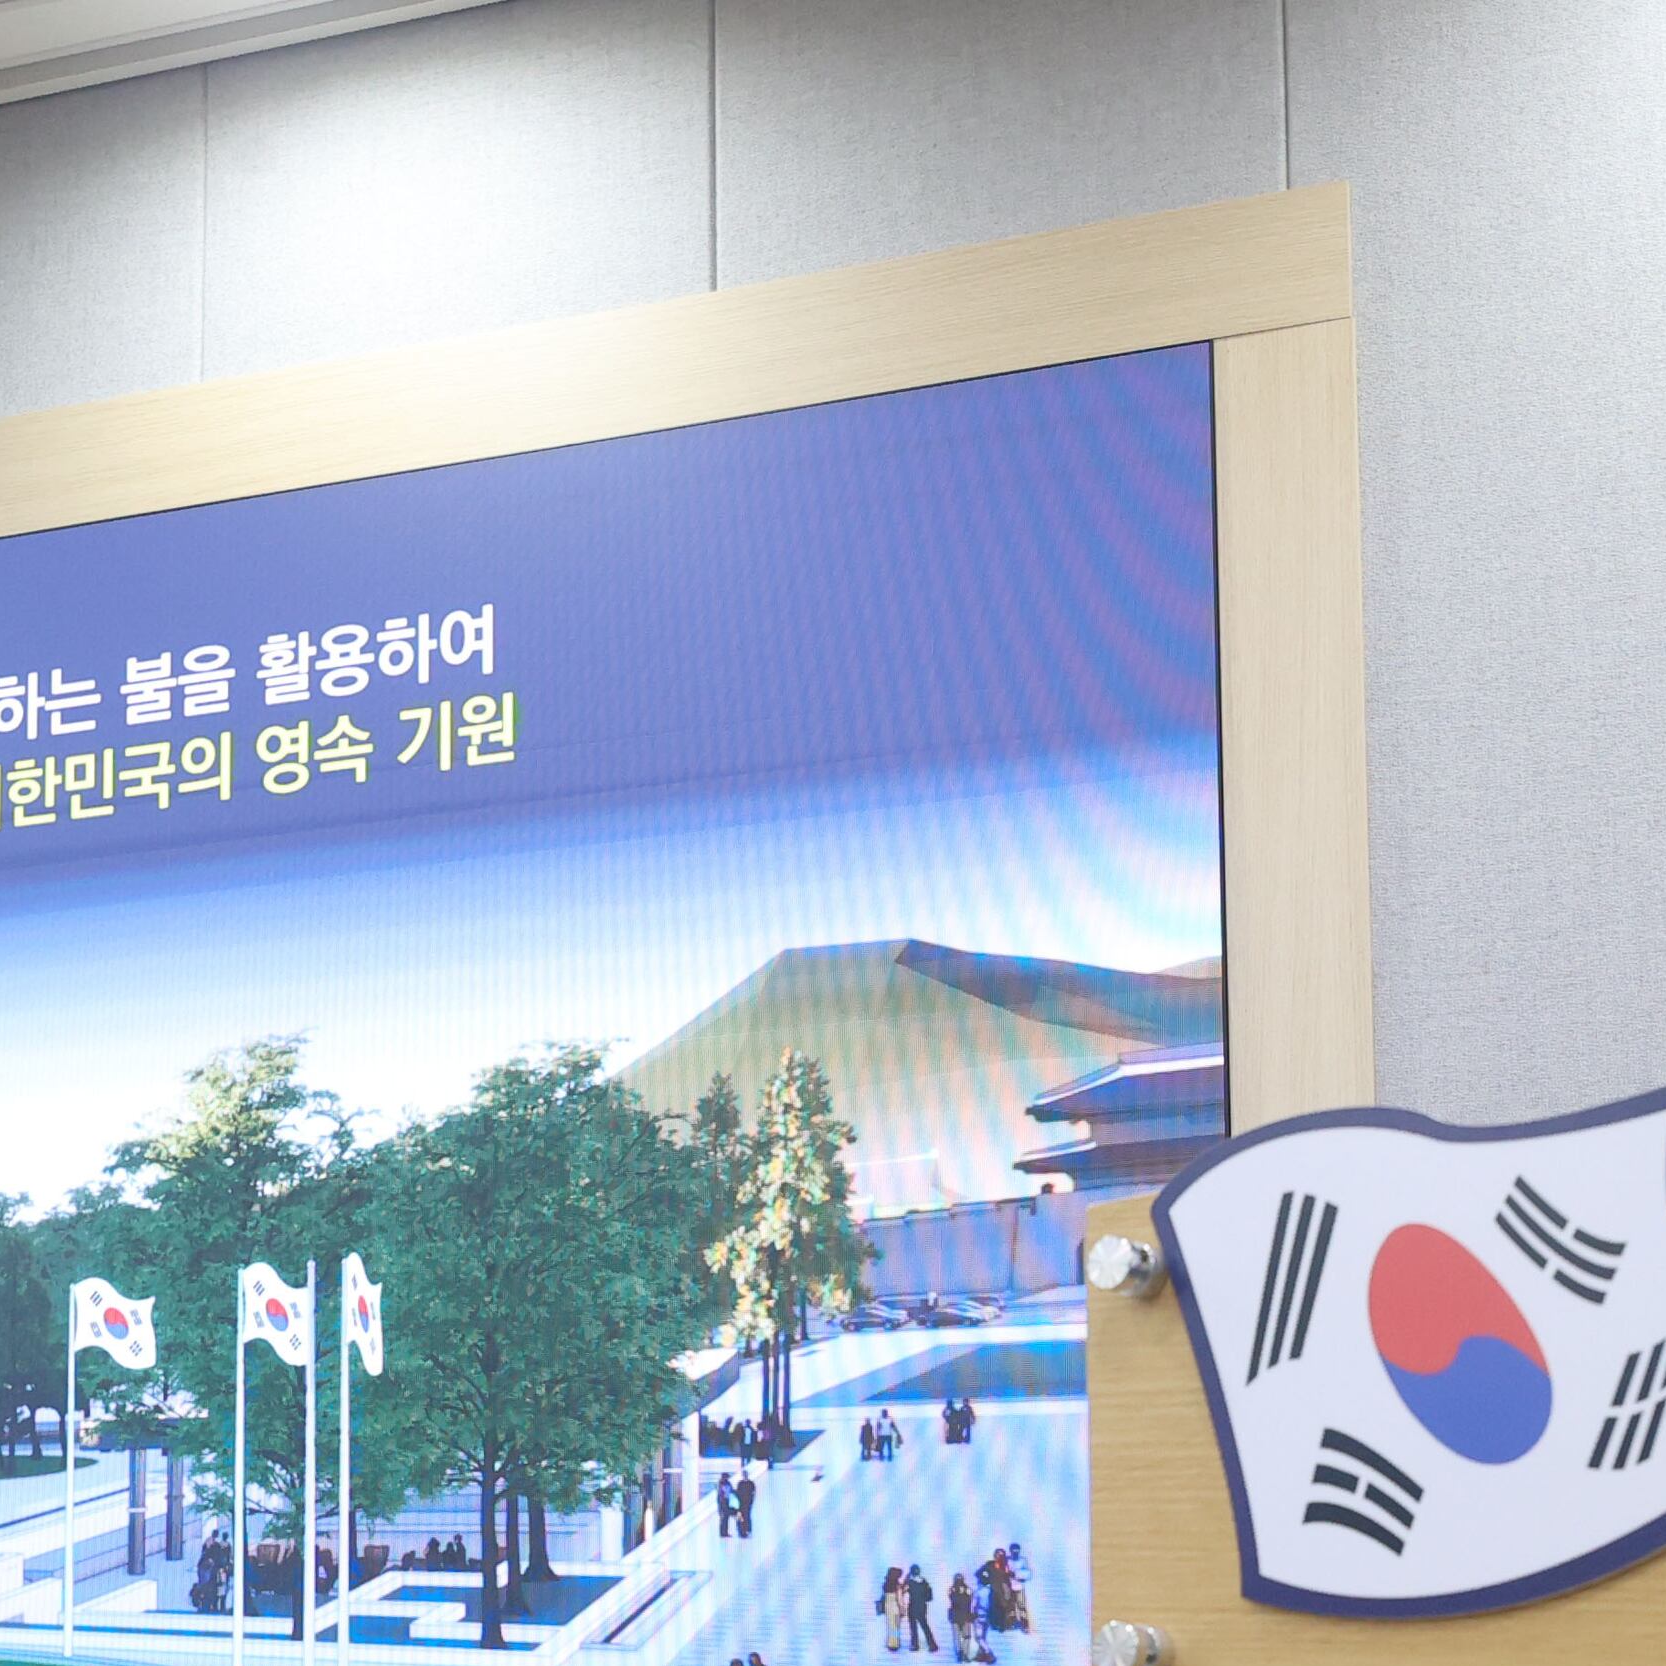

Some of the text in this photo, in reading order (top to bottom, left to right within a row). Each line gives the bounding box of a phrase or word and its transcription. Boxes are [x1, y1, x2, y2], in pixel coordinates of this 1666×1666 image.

[119, 643, 236, 725] 불을
[256, 603, 496, 705] 활용하여
[255, 713, 374, 795] 영속
[396, 691, 517, 772] 기원
